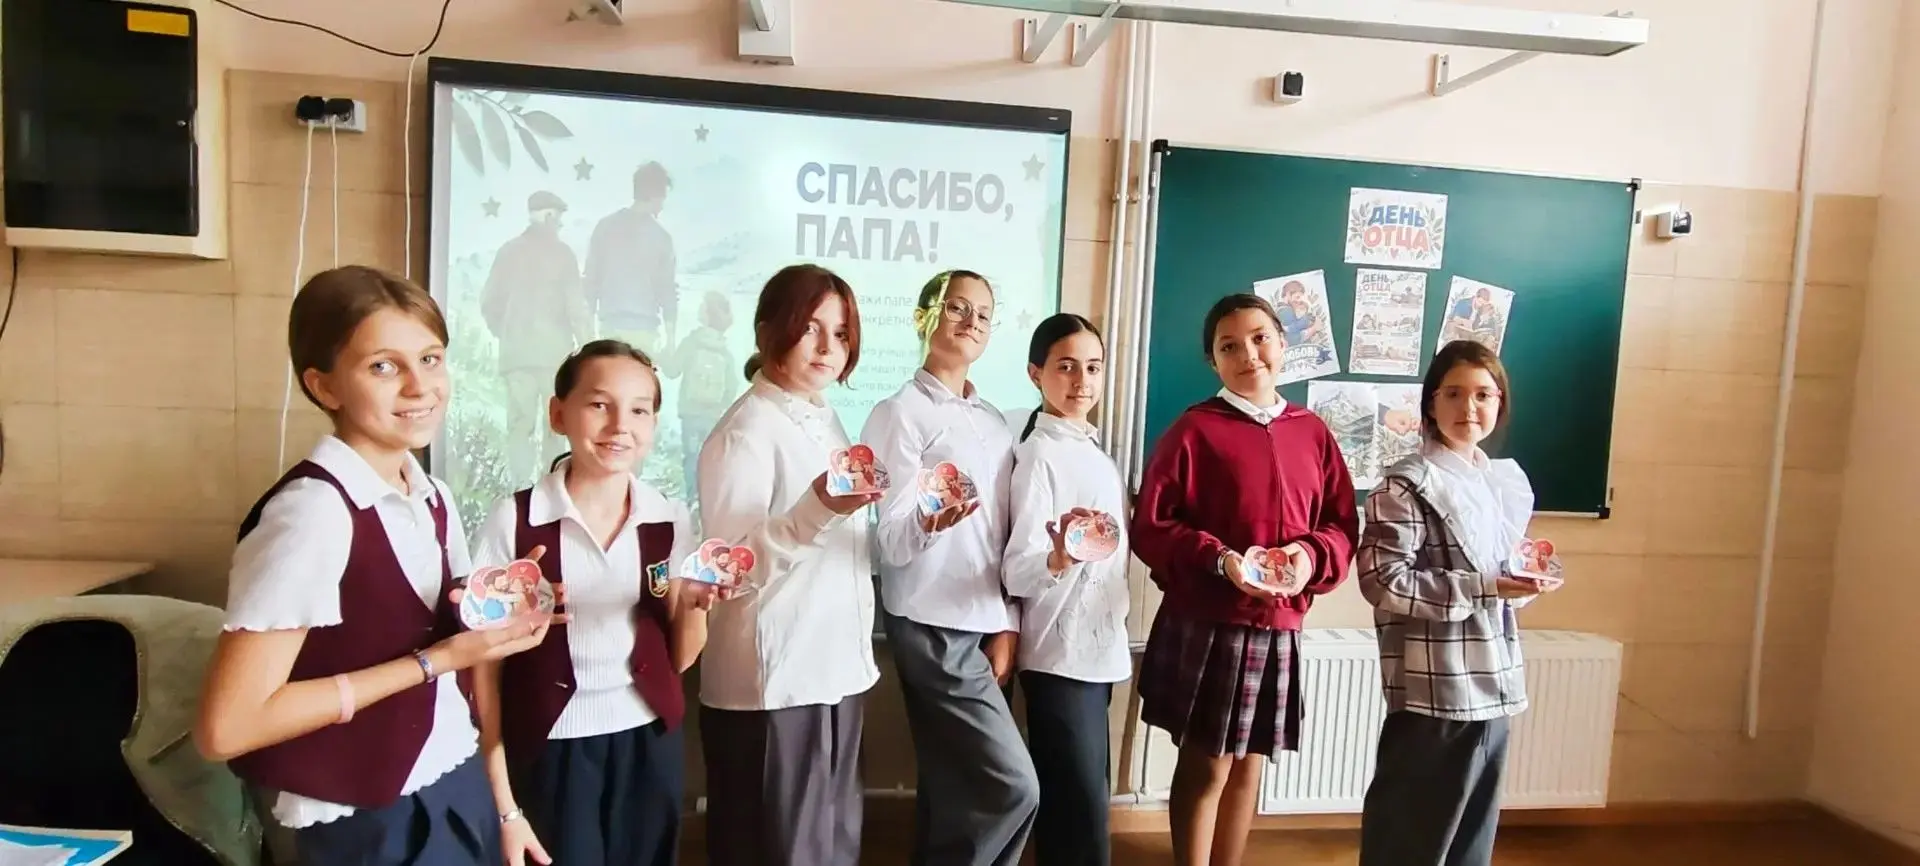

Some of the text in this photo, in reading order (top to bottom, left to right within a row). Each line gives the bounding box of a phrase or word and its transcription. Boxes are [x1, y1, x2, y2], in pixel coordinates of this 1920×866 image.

[796, 161, 1014, 222] СПАСИБО,
[1368, 205, 1426, 227] ДЕНЬ
[795, 213, 940, 264] ПАПА!
[1363, 225, 1429, 252] ОТЦА
[1361, 273, 1390, 284] ДЕНЬ
[1363, 282, 1391, 292] ОТЦА
[857, 295, 881, 305] ажи
[861, 315, 913, 328] нкретно
[1285, 346, 1320, 362] ЮБОВЬ
